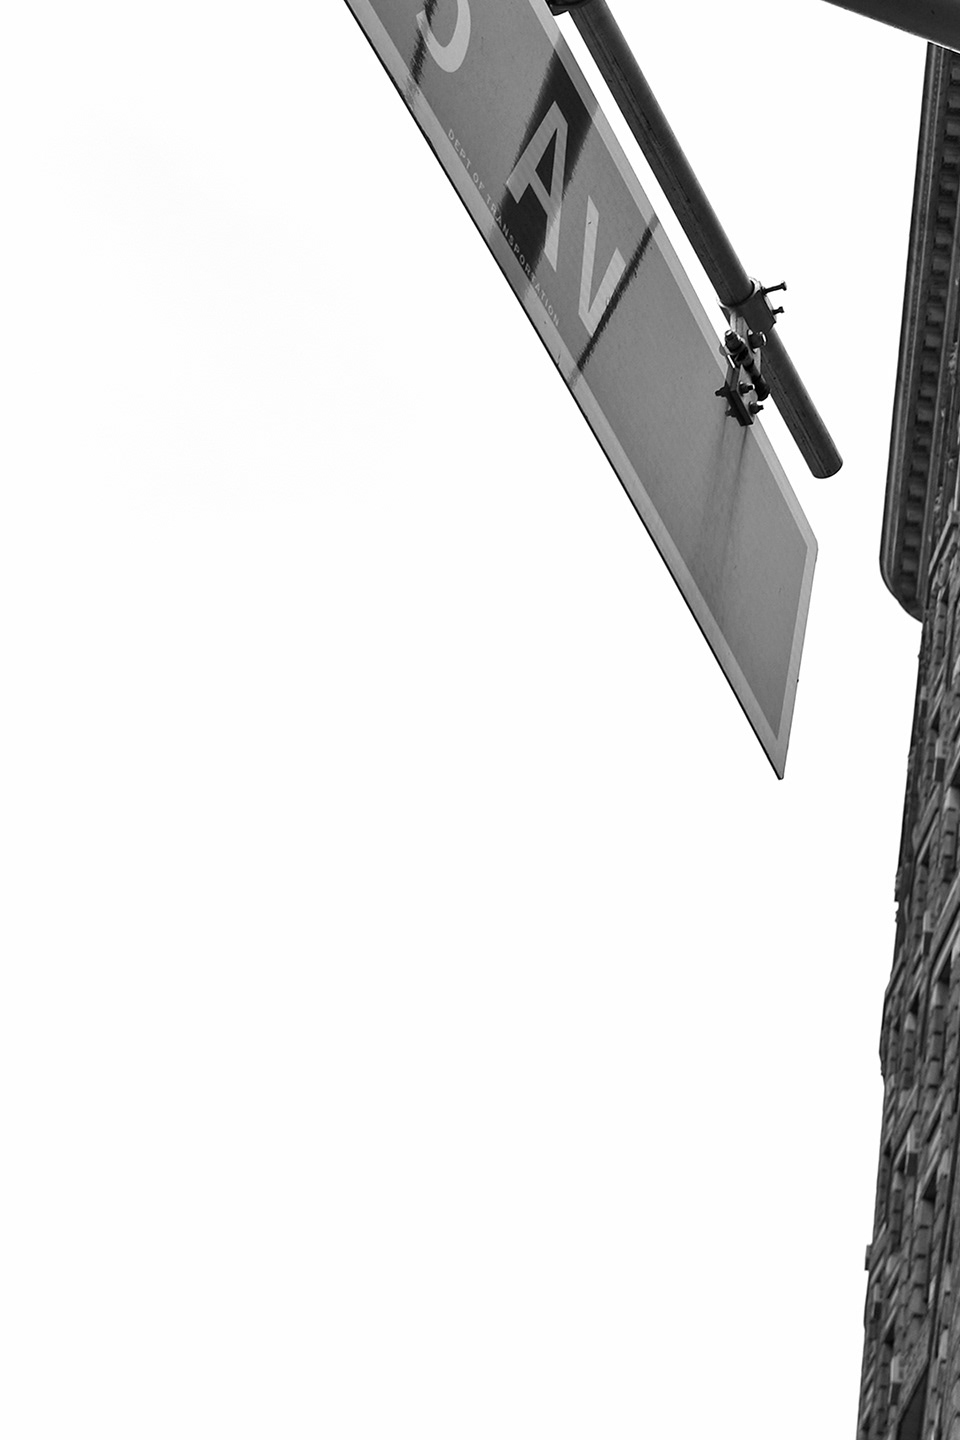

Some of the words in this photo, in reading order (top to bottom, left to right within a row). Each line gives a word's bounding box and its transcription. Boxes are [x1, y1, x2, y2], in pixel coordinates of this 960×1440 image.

[448, 128, 472, 169] DEPT
[472, 171, 485, 190] OF
[486, 194, 560, 327] TRANSPORTATION
[505, 100, 627, 337] AV
